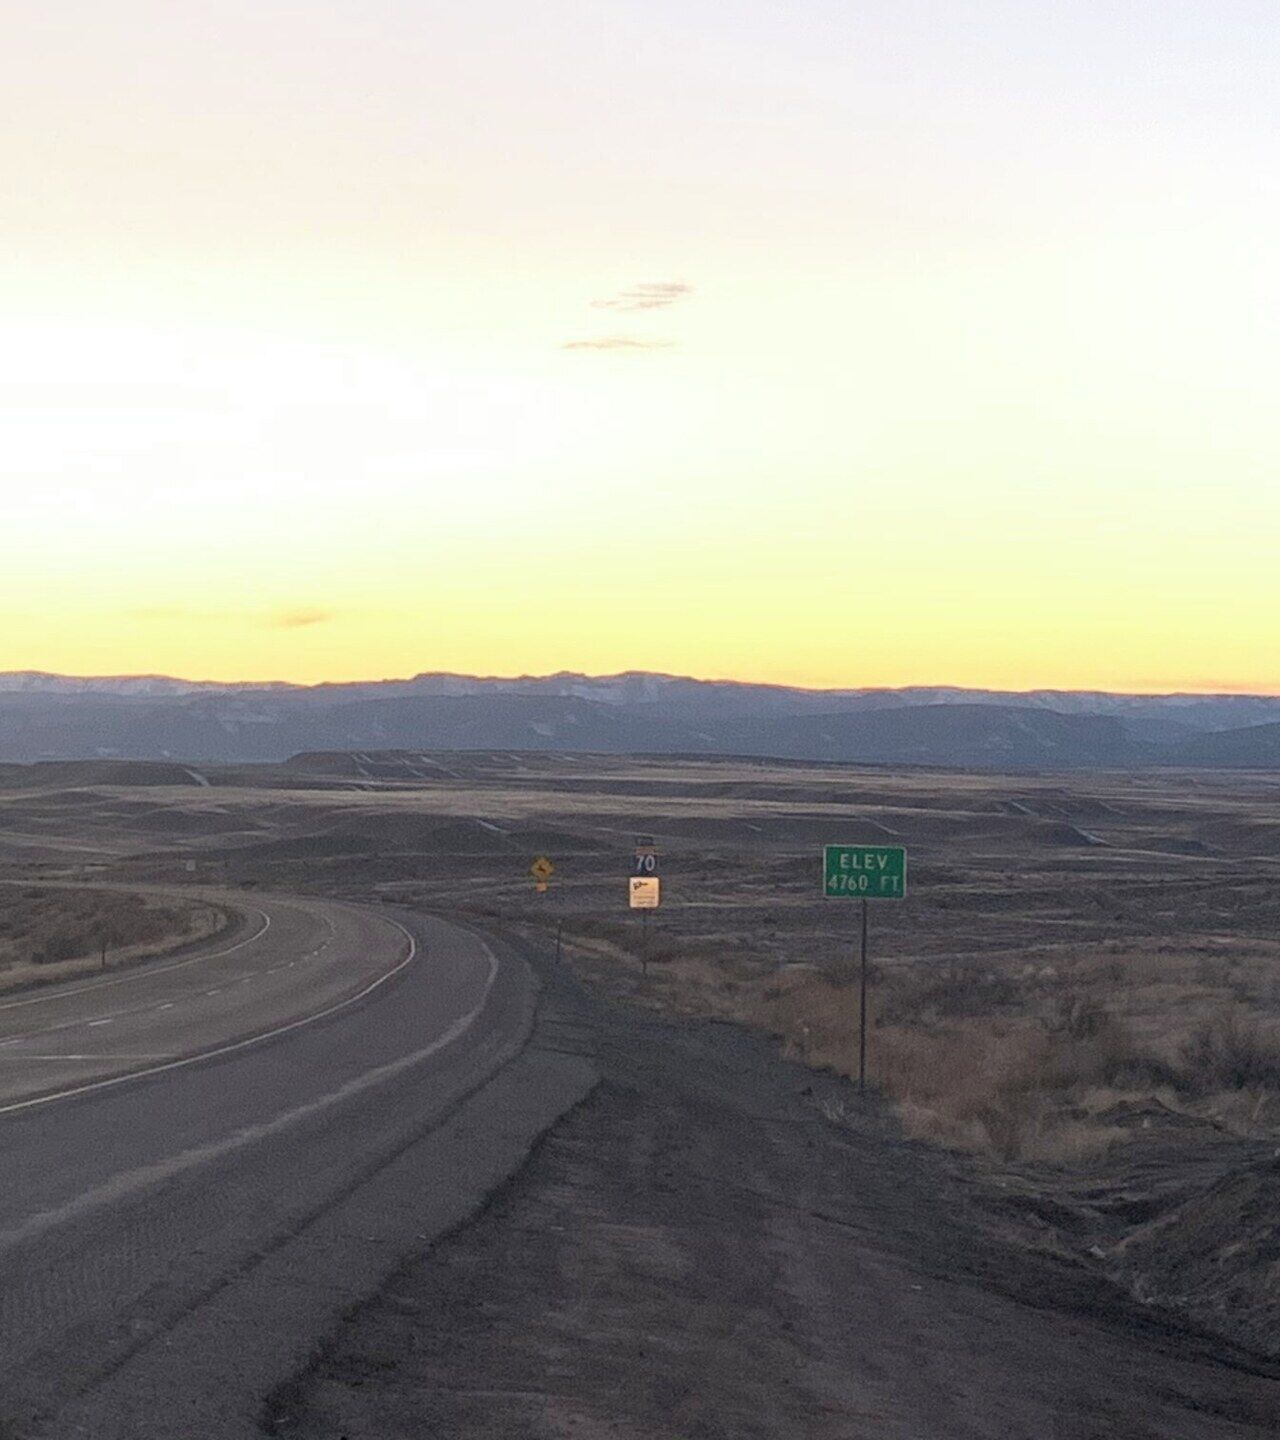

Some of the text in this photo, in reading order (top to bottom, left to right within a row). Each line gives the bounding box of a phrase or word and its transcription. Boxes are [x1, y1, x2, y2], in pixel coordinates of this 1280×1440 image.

[636, 854, 656, 872] 70
[840, 853, 888, 870] ELEV
[827, 874, 899, 891] 4760 FT
